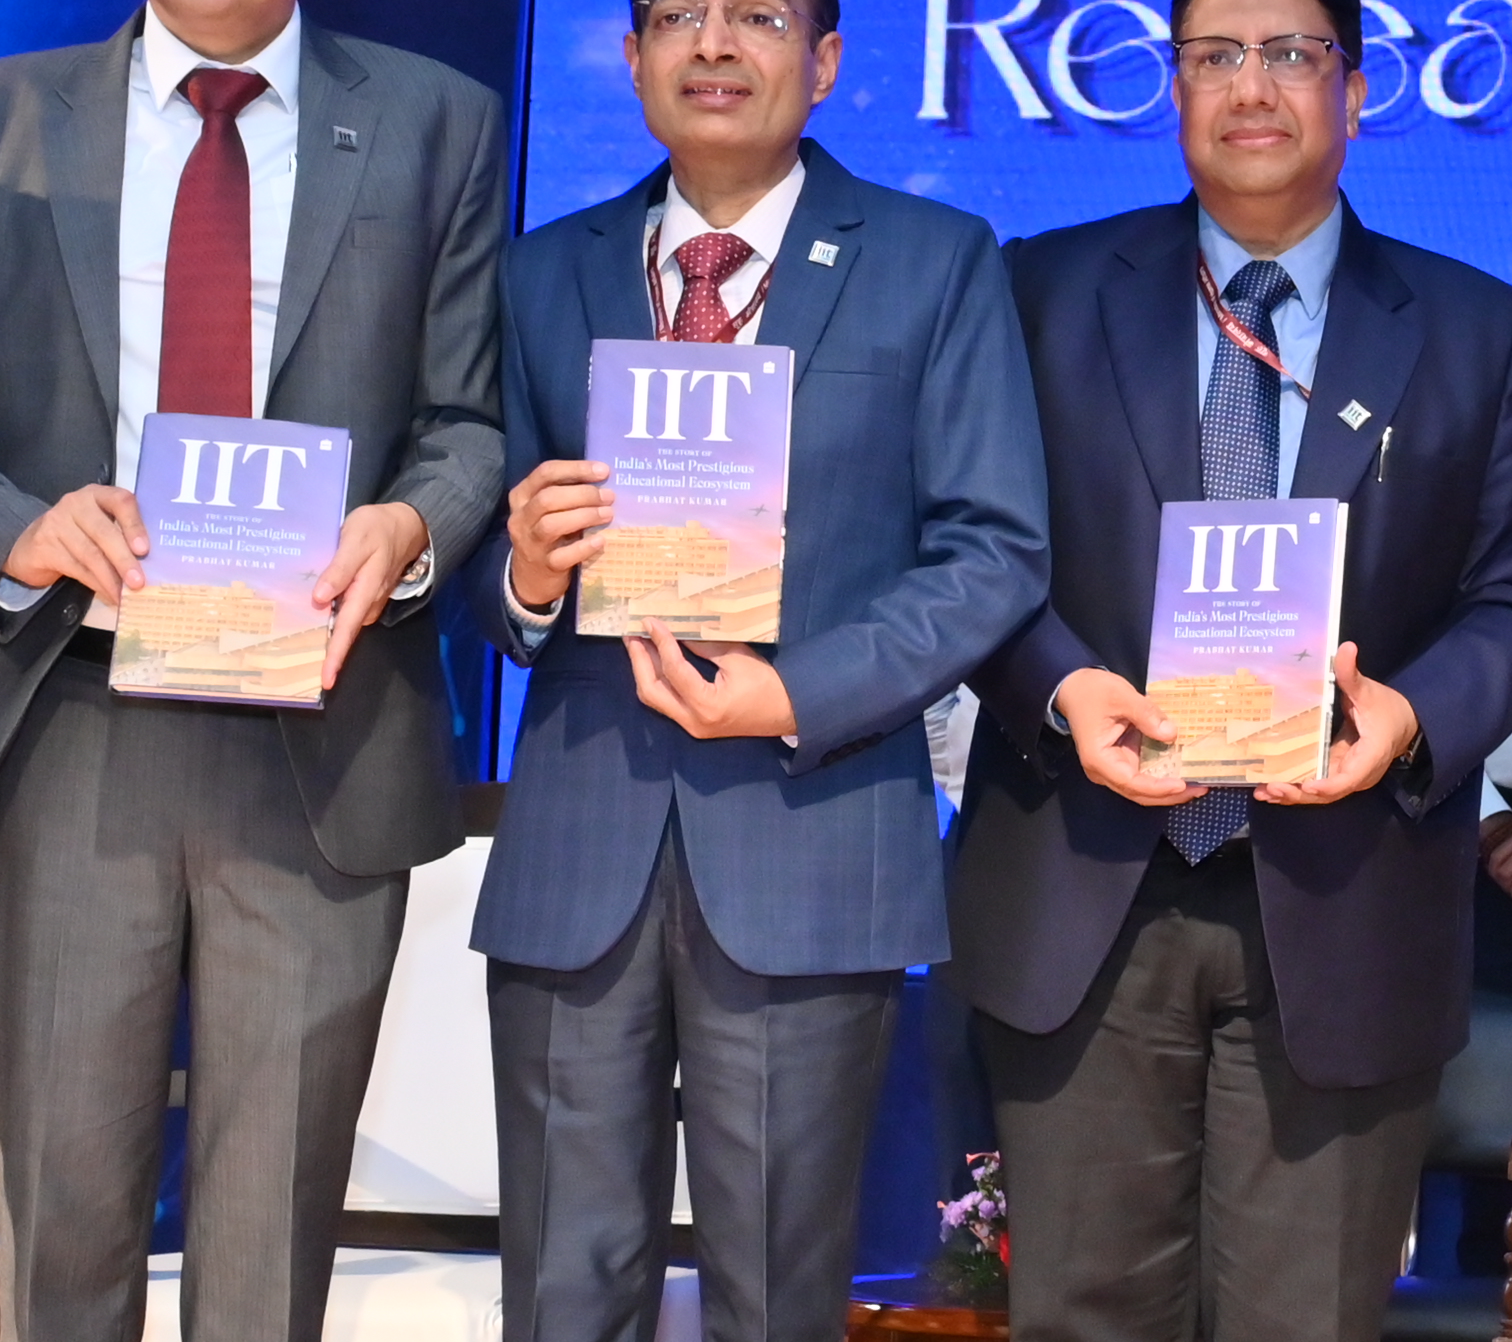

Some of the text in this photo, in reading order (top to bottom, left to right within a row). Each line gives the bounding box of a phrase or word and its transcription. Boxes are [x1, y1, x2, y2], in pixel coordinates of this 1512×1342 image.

[624, 368, 751, 441] IIT
[170, 439, 306, 510] IIT
[655, 459, 685, 471] Most
[688, 460, 754, 475] Prestigious
[615, 474, 751, 492] Educational Ecosystem
[638, 495, 727, 505] PRABHAT KUMAR
[202, 523, 232, 535] Most
[237, 525, 306, 543] Prestigious
[159, 535, 301, 557] Educational Ecosystem
[182, 556, 275, 569] PRABHAT KUMAR
[1183, 524, 1298, 593] IIT
[1210, 611, 1236, 622] Most
[1239, 610, 1298, 624] Prestigious
[1174, 627, 1295, 639] Educational Ecosystem
[1193, 646, 1236, 654] PRABHAT
